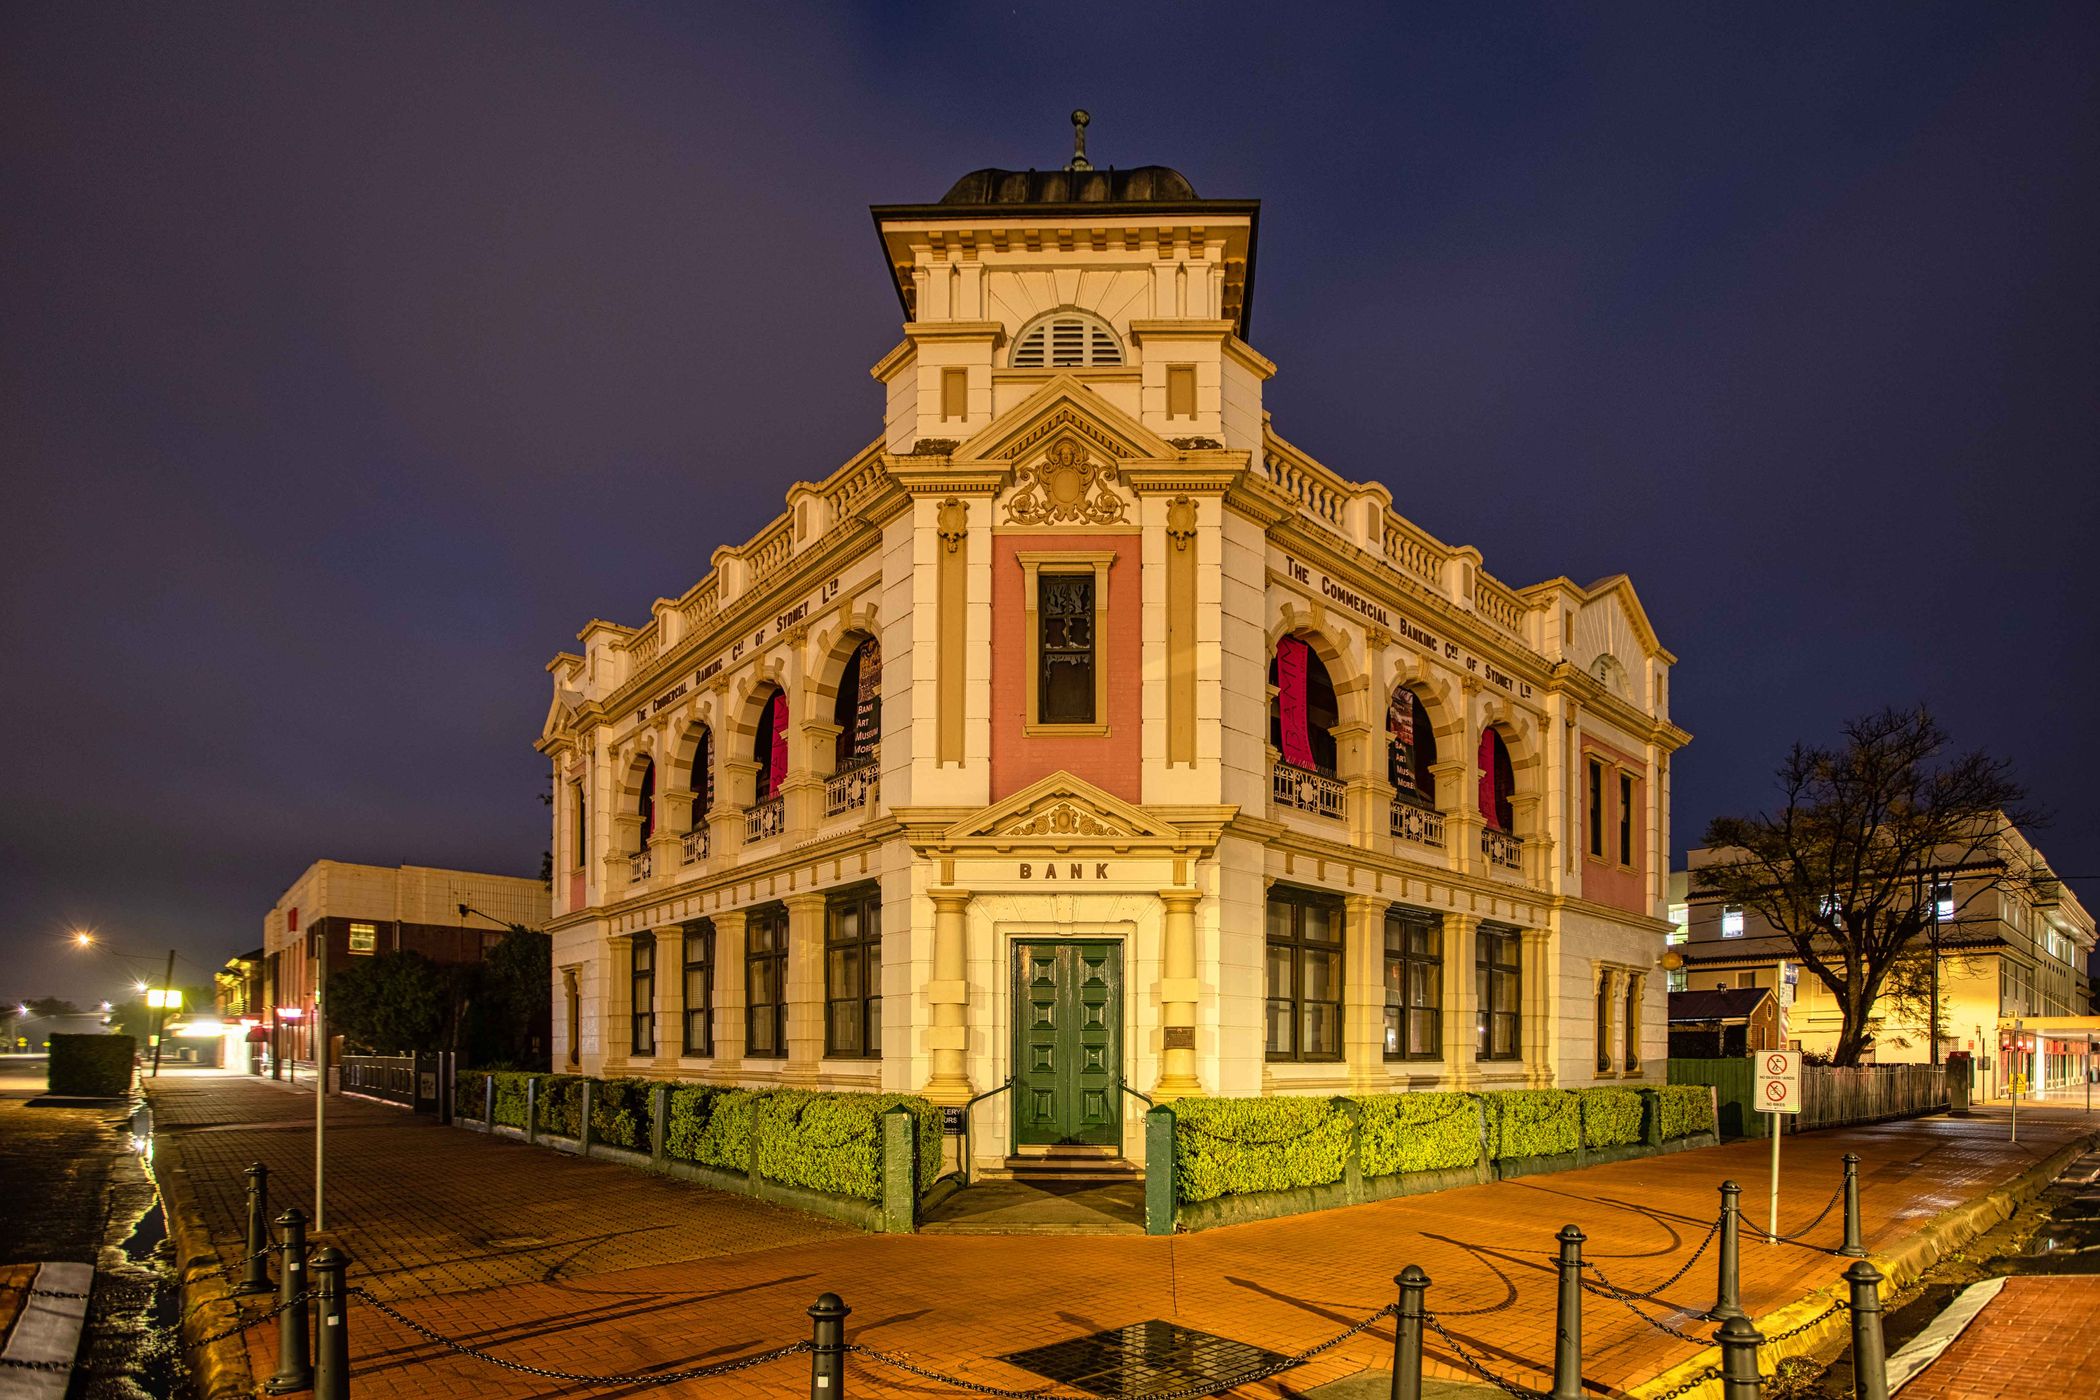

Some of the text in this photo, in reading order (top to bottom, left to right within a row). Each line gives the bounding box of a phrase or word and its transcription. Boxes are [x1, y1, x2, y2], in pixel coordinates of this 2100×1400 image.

[755, 629, 765, 646] OF
[776, 600, 809, 633] SYDNEY
[1286, 555, 1309, 585] THE
[1321, 576, 1389, 627] COMMERCIAL
[1400, 617, 1437, 651] BANKING
[1466, 656, 1477, 672] OF
[1485, 664, 1513, 692] SYDNEY
[858, 702, 874, 715] BANK
[856, 718, 869, 728] ART
[1019, 863, 1109, 879] BANK
